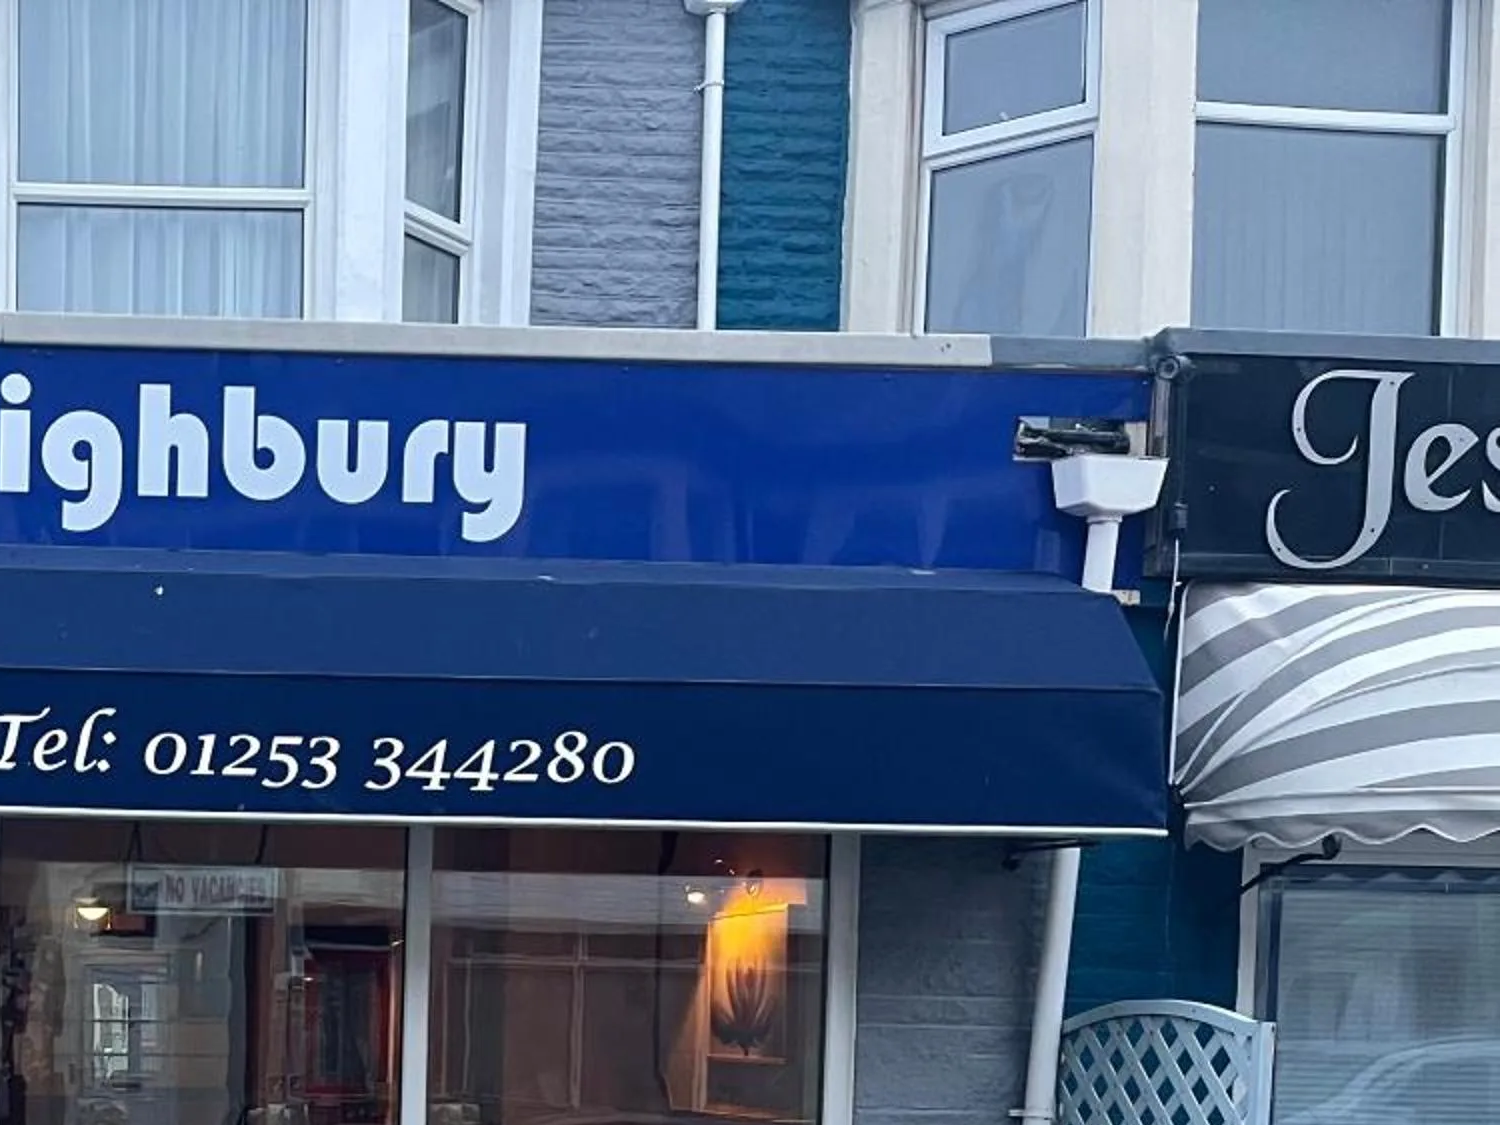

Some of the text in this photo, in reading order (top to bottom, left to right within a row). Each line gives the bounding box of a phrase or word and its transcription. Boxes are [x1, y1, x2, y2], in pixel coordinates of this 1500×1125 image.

[143, 731, 340, 790] 01253
[364, 730, 636, 793] 344280
[165, 874, 185, 903] NO
